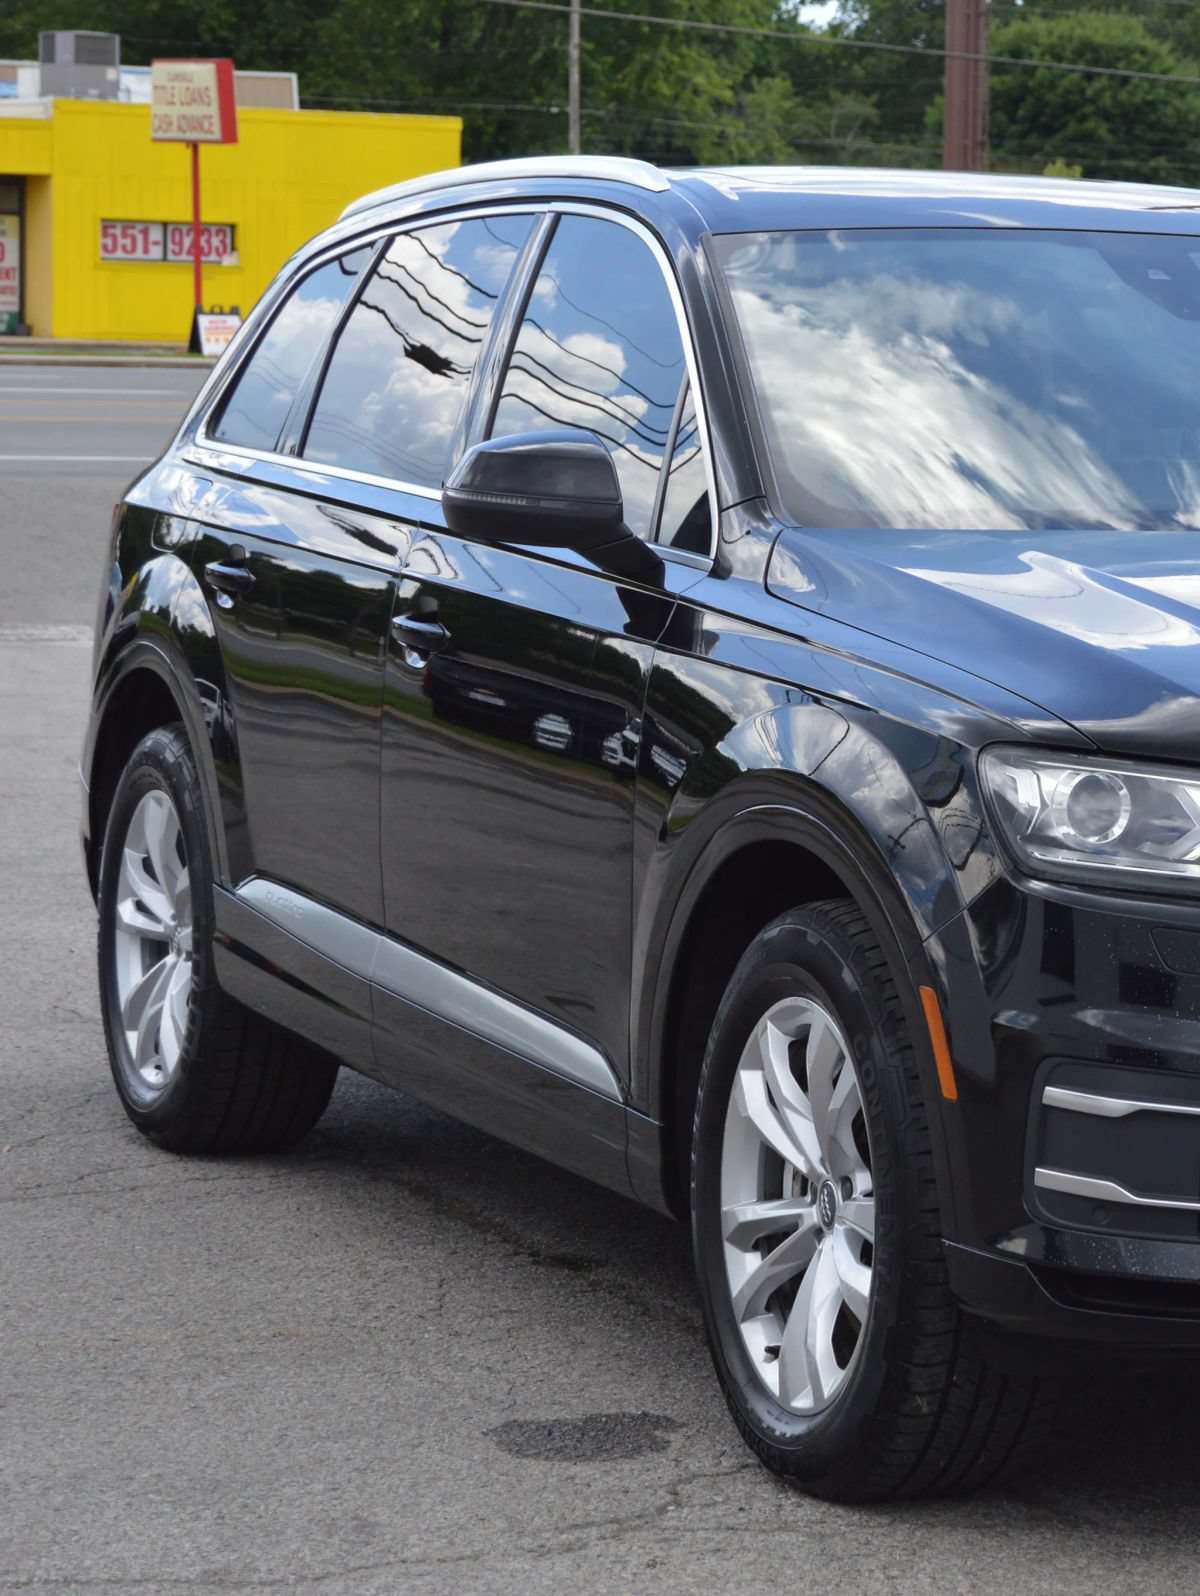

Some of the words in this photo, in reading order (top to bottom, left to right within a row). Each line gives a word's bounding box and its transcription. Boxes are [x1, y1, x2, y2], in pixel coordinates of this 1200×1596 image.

[180, 85, 211, 108] LOANS
[152, 113, 175, 133] CASH
[177, 114, 215, 135] ADVANCE
